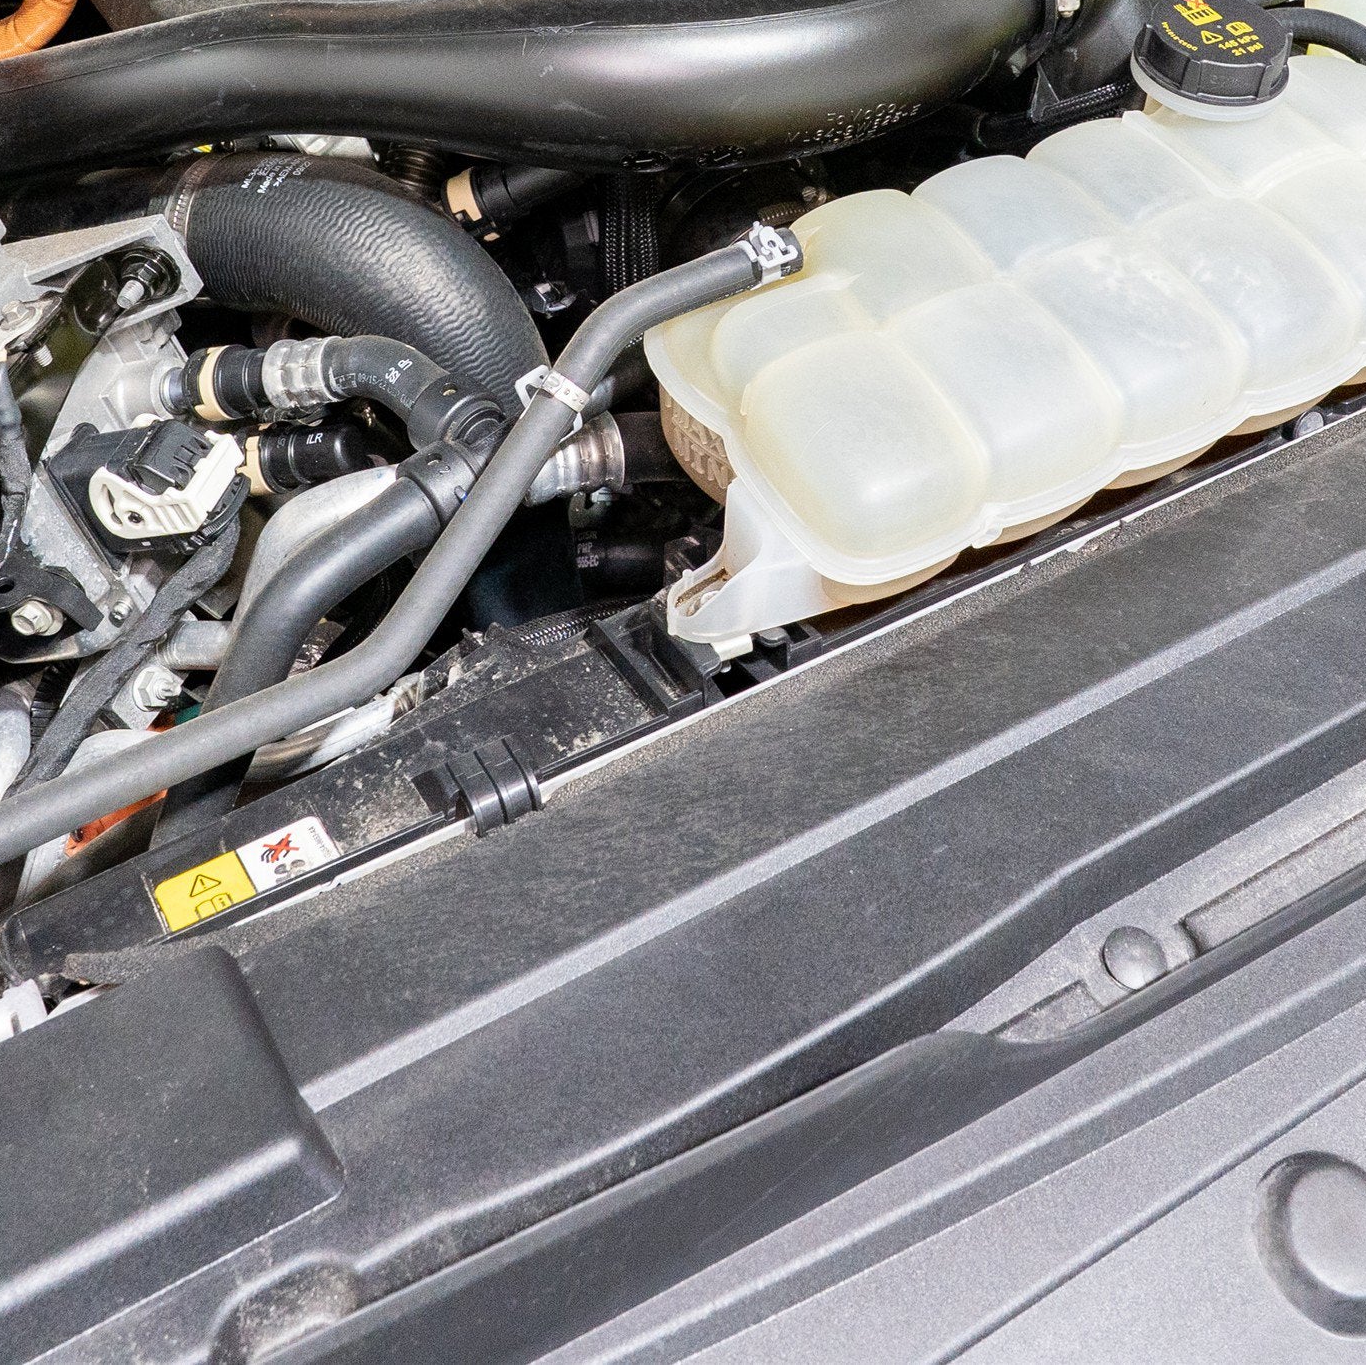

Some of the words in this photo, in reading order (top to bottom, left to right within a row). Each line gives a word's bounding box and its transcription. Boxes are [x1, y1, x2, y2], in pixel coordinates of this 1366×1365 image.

[1218, 40, 1239, 50] 145
[1237, 35, 1260, 44] kPa
[1232, 47, 1247, 56] 21
[1246, 42, 1264, 53] psi
[674, 423, 729, 490] MIN
